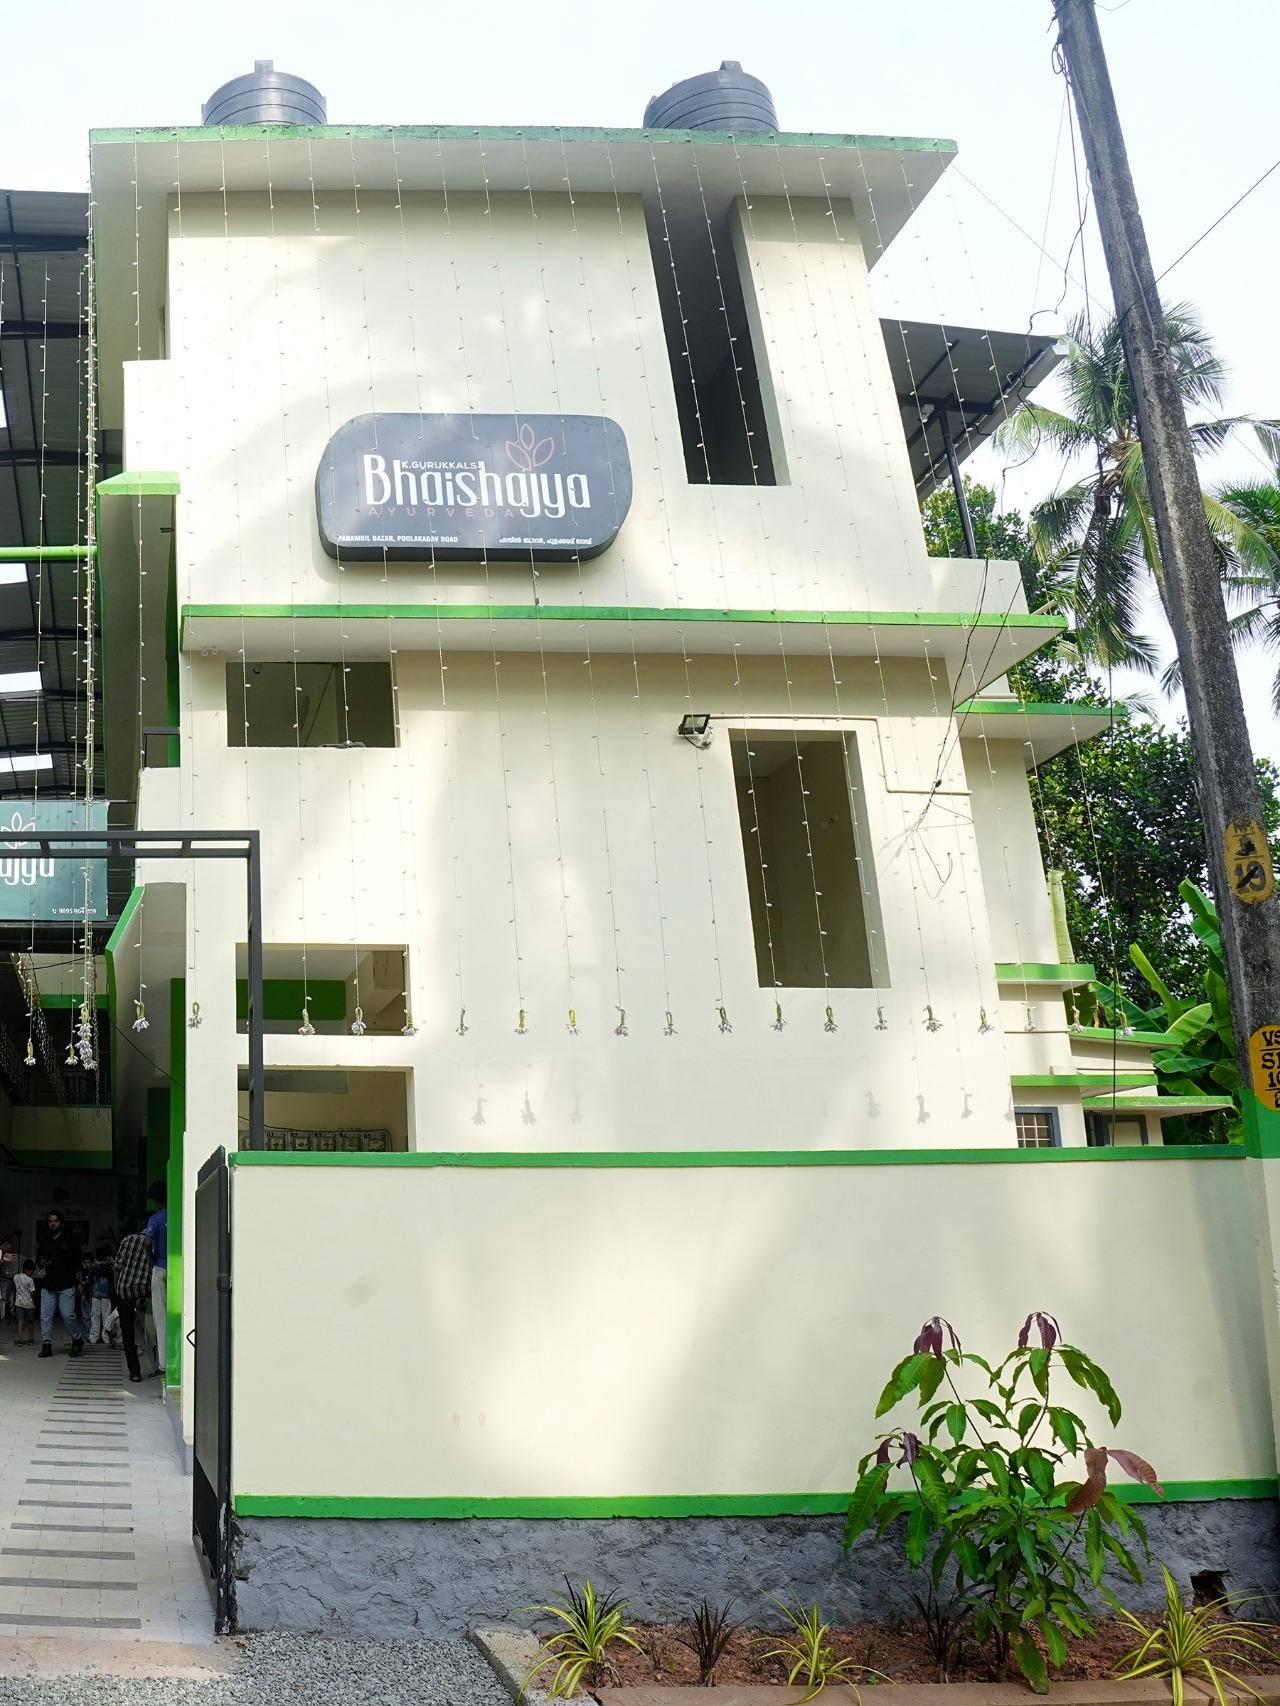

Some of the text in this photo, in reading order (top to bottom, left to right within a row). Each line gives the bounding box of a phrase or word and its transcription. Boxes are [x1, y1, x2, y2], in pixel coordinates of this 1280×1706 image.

[363, 454, 591, 518] Bhaishajya
[367, 506, 515, 518] AYURVEDA
[372, 535, 396, 543] BAZAR,
